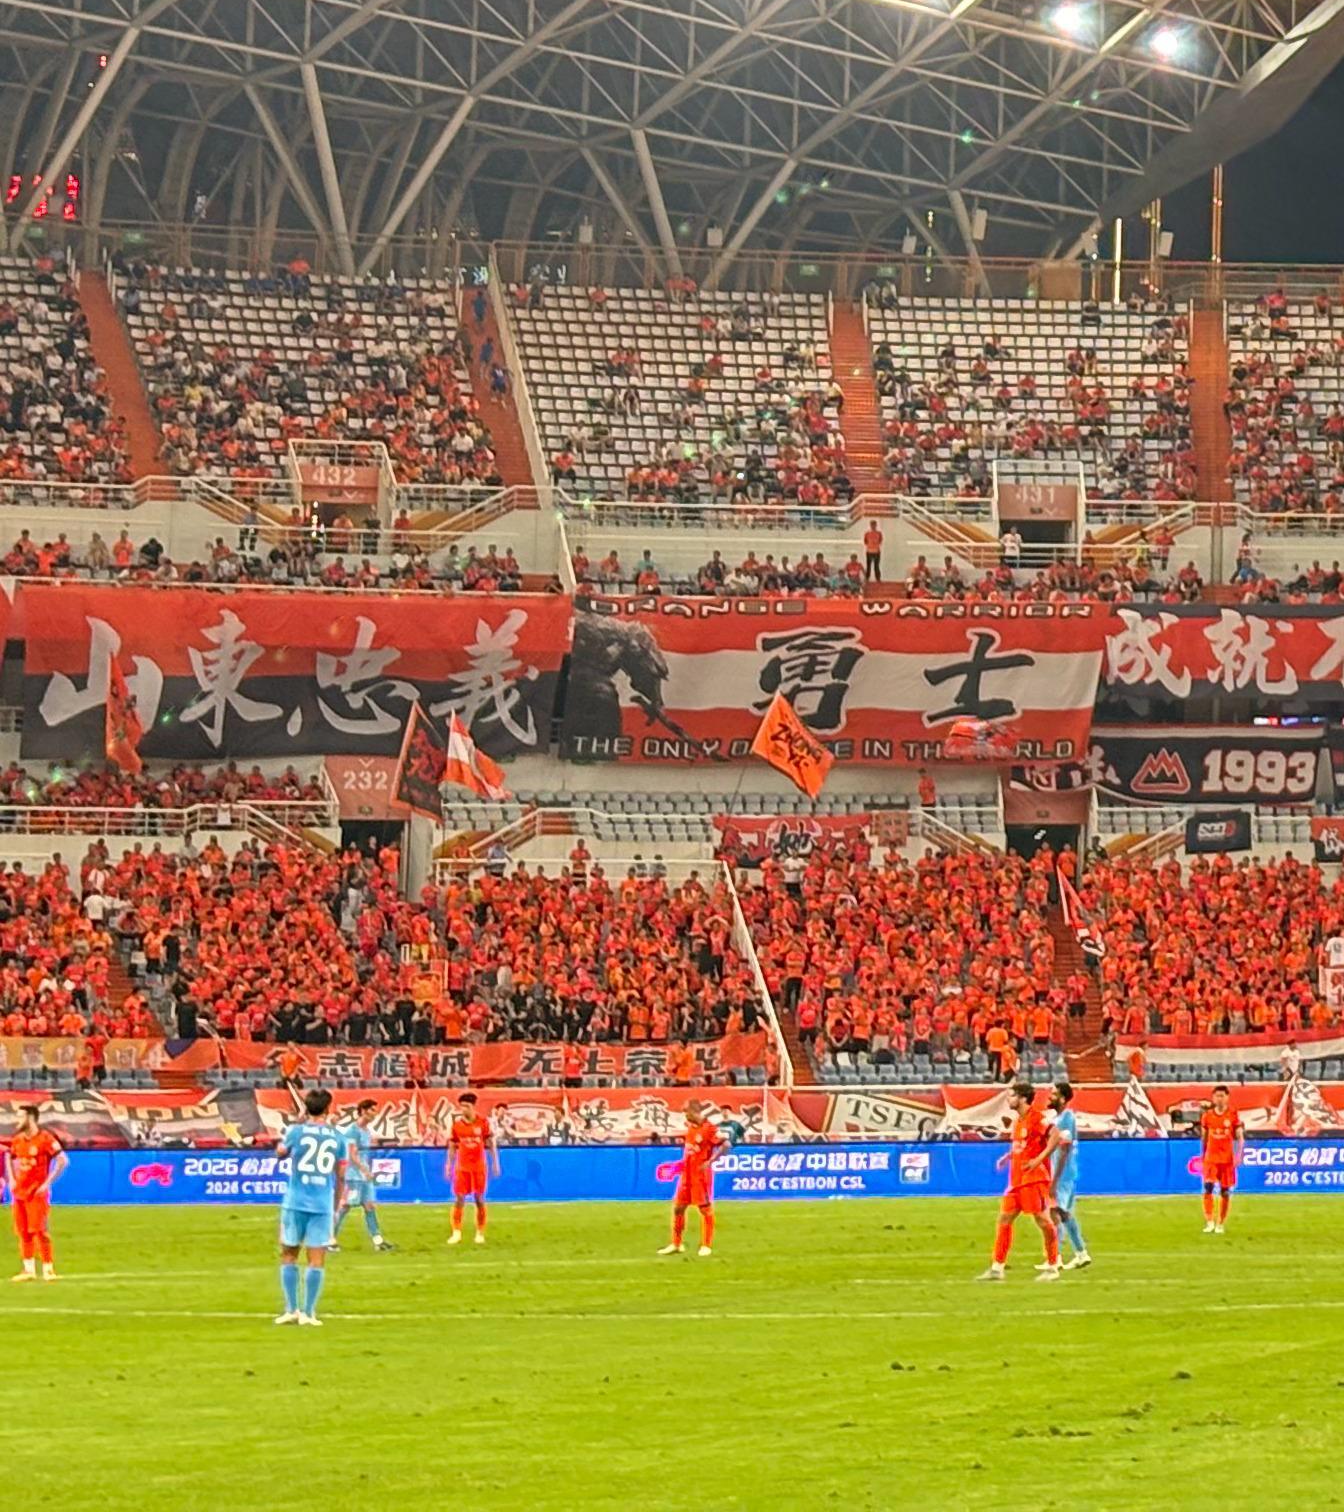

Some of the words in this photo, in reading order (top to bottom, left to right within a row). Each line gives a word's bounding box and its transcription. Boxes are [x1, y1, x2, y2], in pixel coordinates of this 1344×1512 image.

[312, 467, 356, 486] 432
[573, 736, 631, 756] THE
[644, 738, 719, 760] ONLY
[864, 740, 892, 758] IN
[343, 769, 389, 791] 232
[1201, 748, 1317, 794] 1993
[297, 1136, 338, 1175] 26
[205, 1180, 239, 1195] 2026
[732, 1176, 766, 1191] 2026
[769, 1176, 837, 1191] C'ESTBON
[840, 1175, 866, 1190] CSL
[1264, 1171, 1299, 1185] 2026
